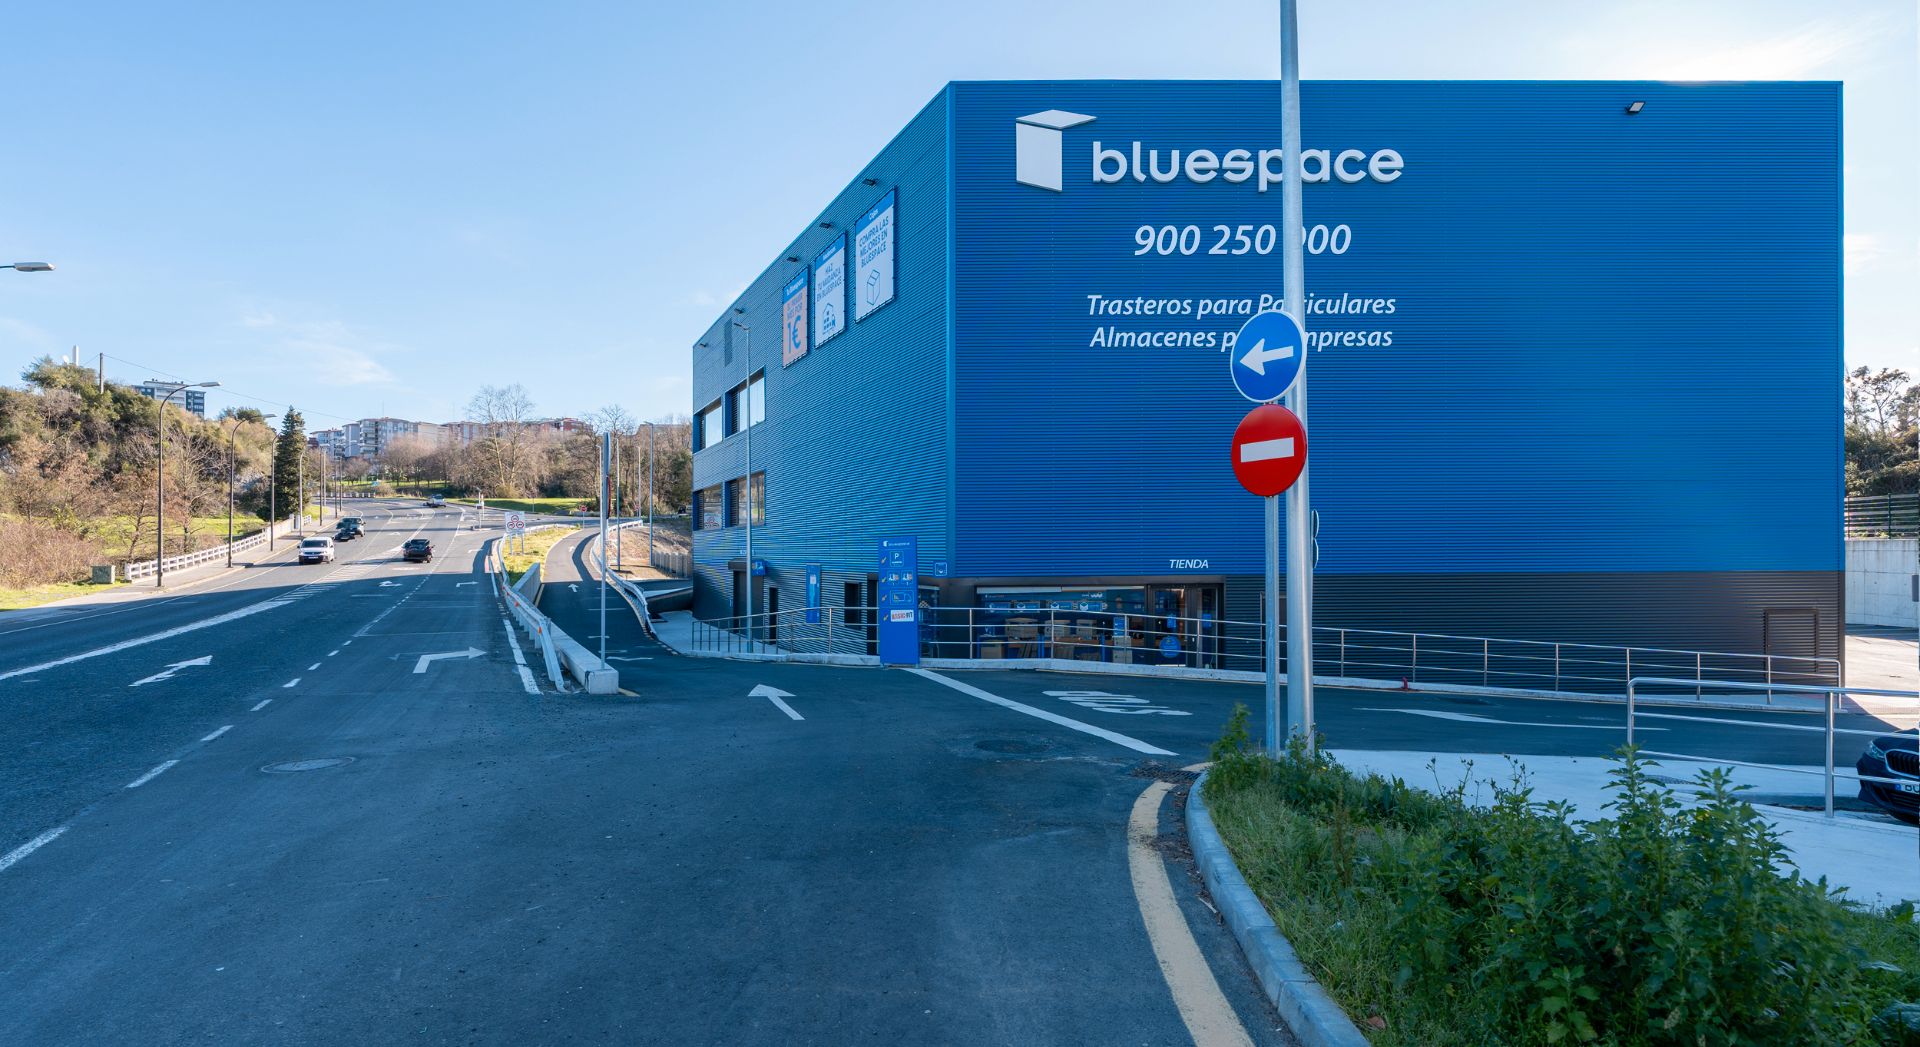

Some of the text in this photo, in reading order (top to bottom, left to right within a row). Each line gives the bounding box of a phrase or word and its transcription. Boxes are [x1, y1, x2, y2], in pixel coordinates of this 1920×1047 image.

[1092, 141, 1404, 193] bluespace
[879, 216, 889, 231] LAS
[1134, 224, 1352, 256] 900 250 00
[861, 241, 887, 268] BLUESPACE
[1087, 293, 1396, 320] Trasteros para Paiculares
[787, 315, 802, 354] 1€
[1089, 327, 1217, 347] Almacenes
[1304, 331, 1393, 353] mpresas
[1169, 559, 1209, 569] TIENDA
